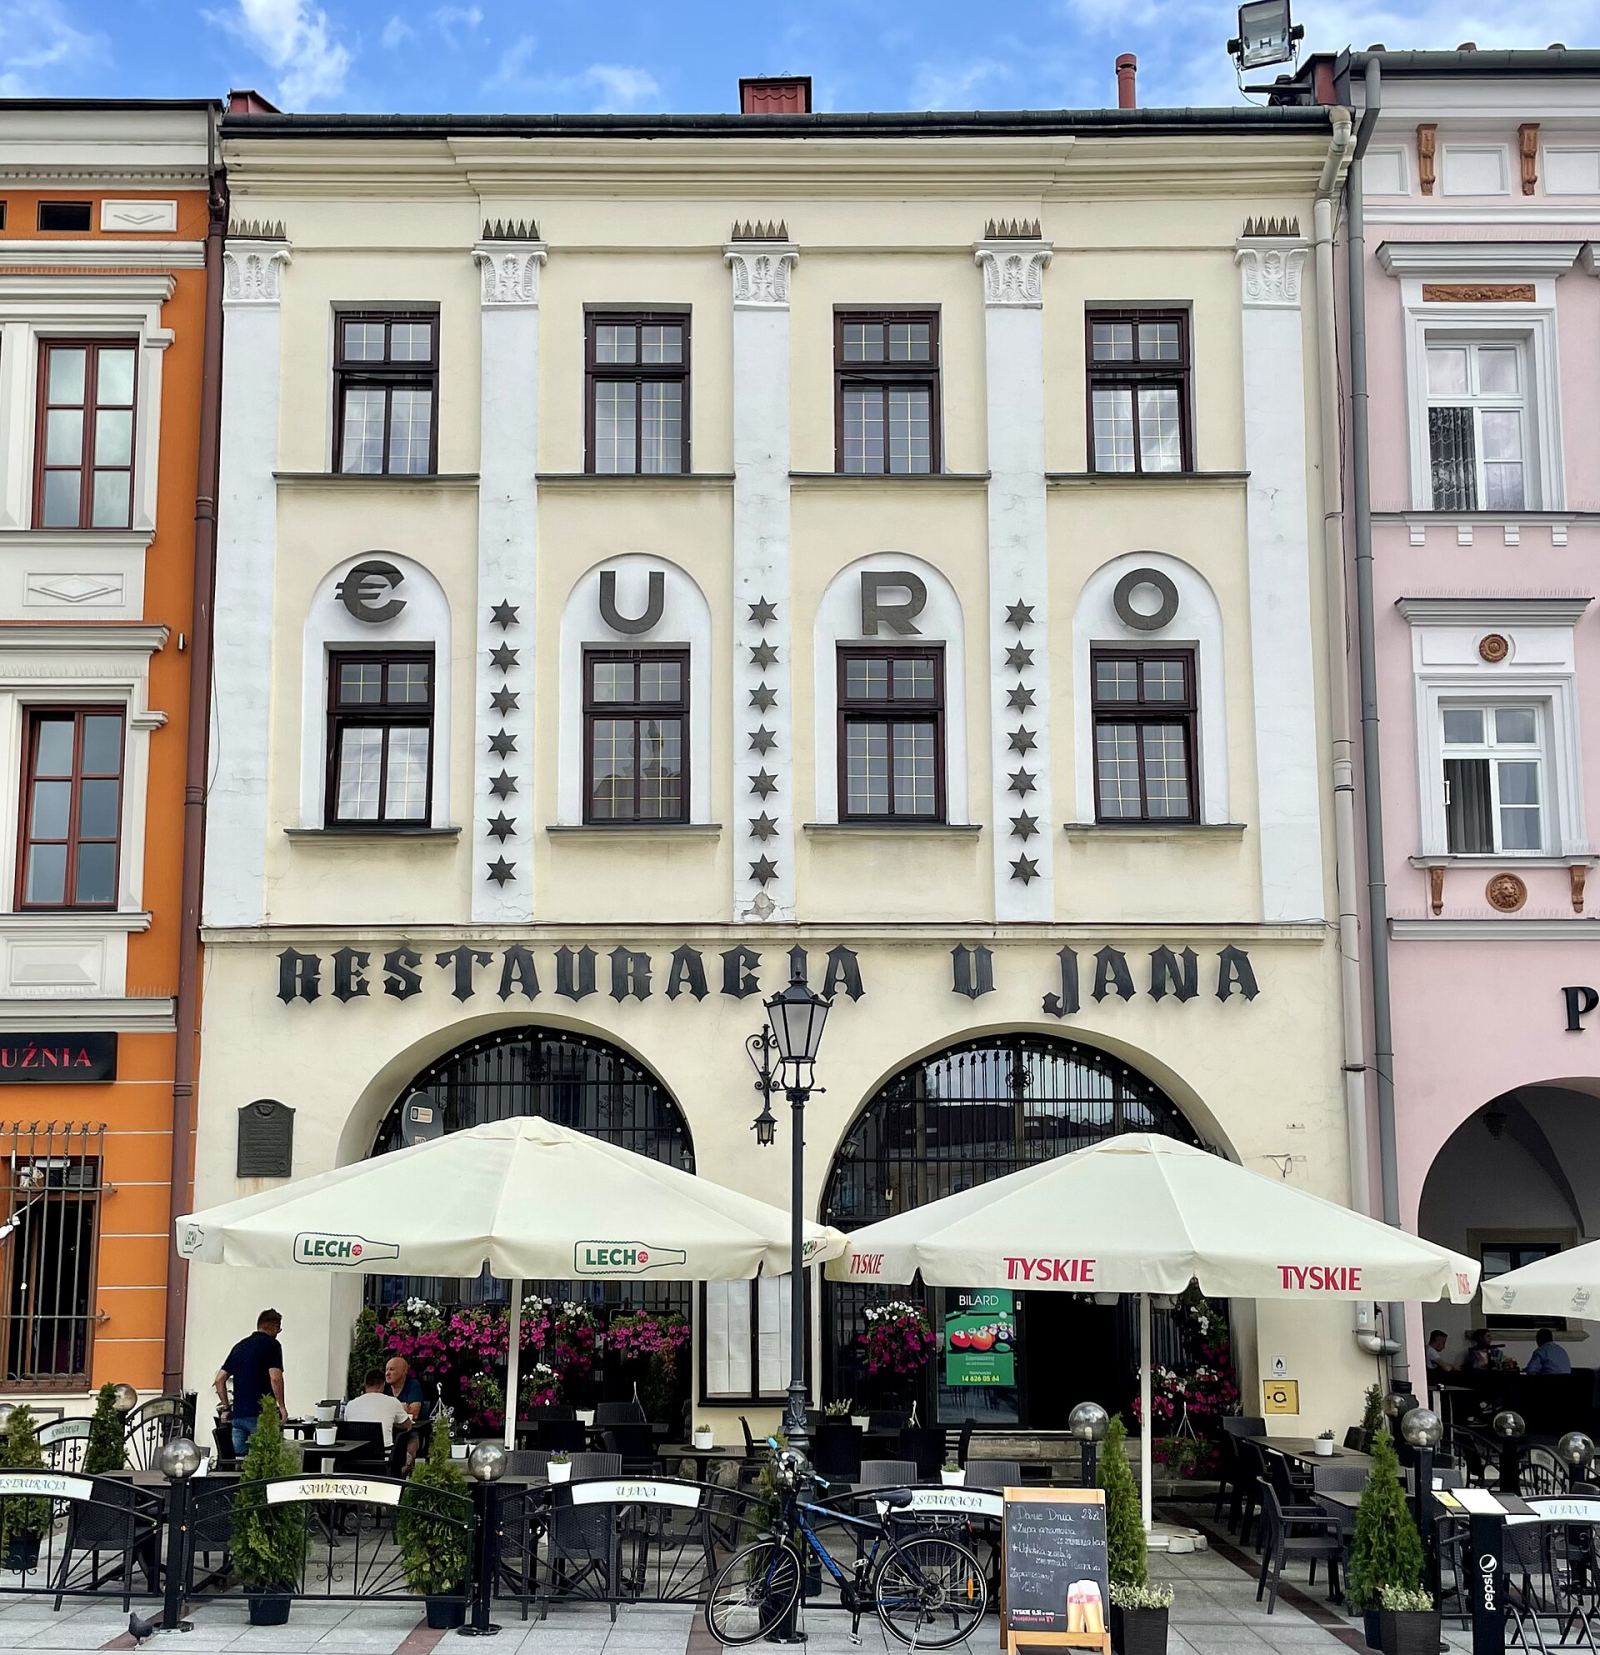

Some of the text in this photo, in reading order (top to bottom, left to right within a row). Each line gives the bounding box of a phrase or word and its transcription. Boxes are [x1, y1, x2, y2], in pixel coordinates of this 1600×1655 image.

[950, 942, 996, 1000] U
[1042, 944, 1260, 1019] JANA
[1561, 987, 1599, 1031] P
[1, 1041, 92, 1068] UŹNIA
[303, 1239, 350, 1257] LECH
[585, 1249, 636, 1265] LECH
[849, 1254, 884, 1274] TYSKIE
[1003, 1257, 1096, 1282] TYSKIE
[1277, 1265, 1362, 1291] TYSKIE
[959, 1295, 999, 1306] BILARD
[912, 1495, 982, 1507] ESTAURACJA
[1484, 1573, 1496, 1611] pepsi
